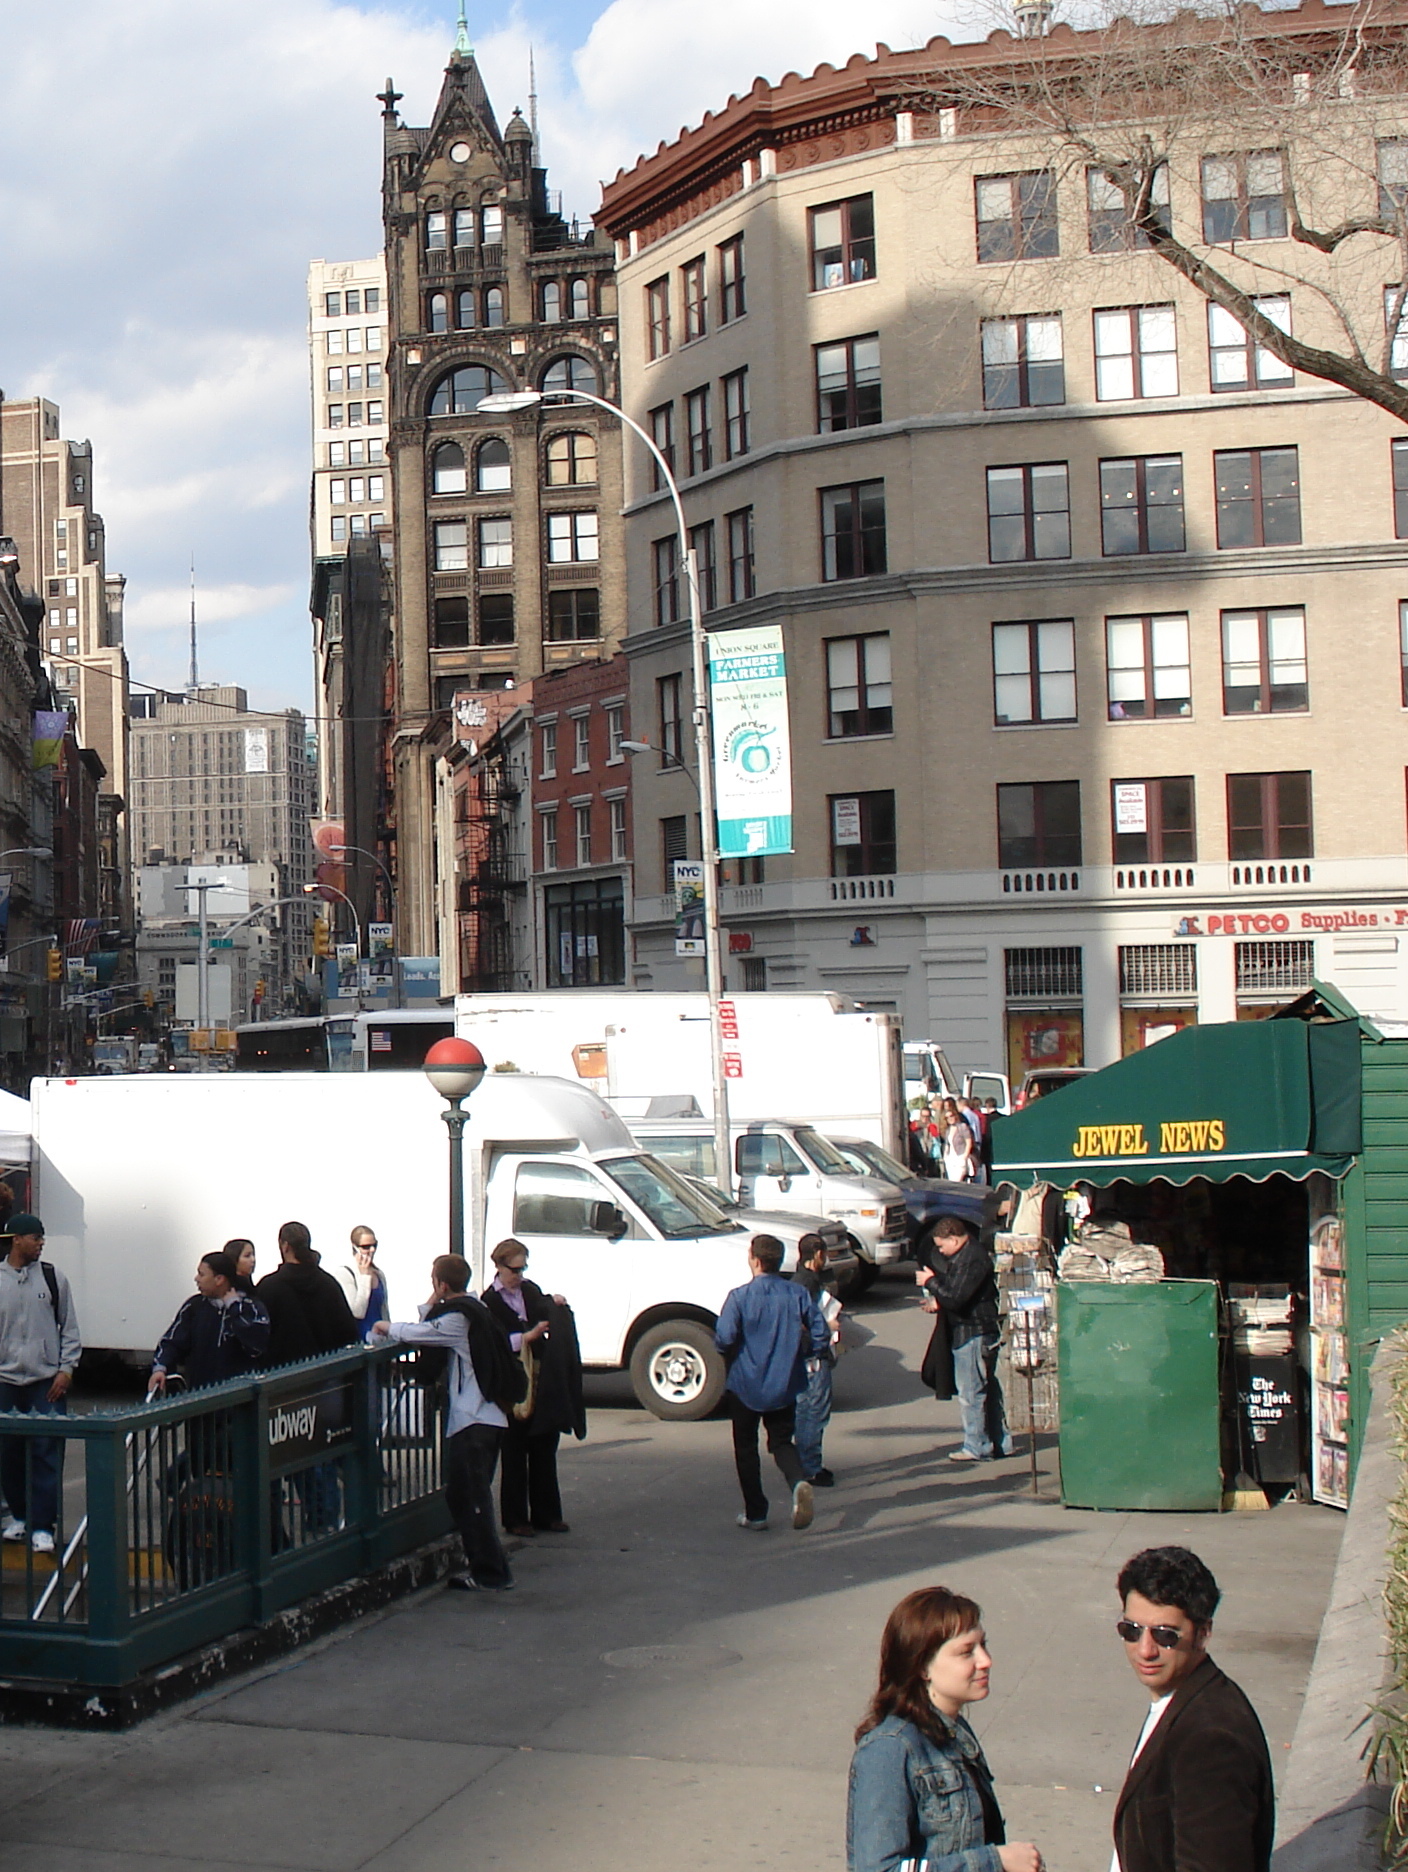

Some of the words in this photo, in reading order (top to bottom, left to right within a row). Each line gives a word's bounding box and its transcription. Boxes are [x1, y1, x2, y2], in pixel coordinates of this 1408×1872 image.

[744, 642, 780, 653] SQUARE
[715, 655, 778, 671] FARMERS
[716, 665, 779, 682] MARKET
[677, 866, 700, 877] NYC
[1207, 913, 1290, 935] PETCO
[1301, 910, 1378, 932] Supplies
[1073, 1124, 1148, 1158] JEWEL
[1160, 1119, 1226, 1154] NEWS
[1252, 1376, 1276, 1391] The
[1262, 1390, 1292, 1408] York
[1247, 1404, 1284, 1419] Times
